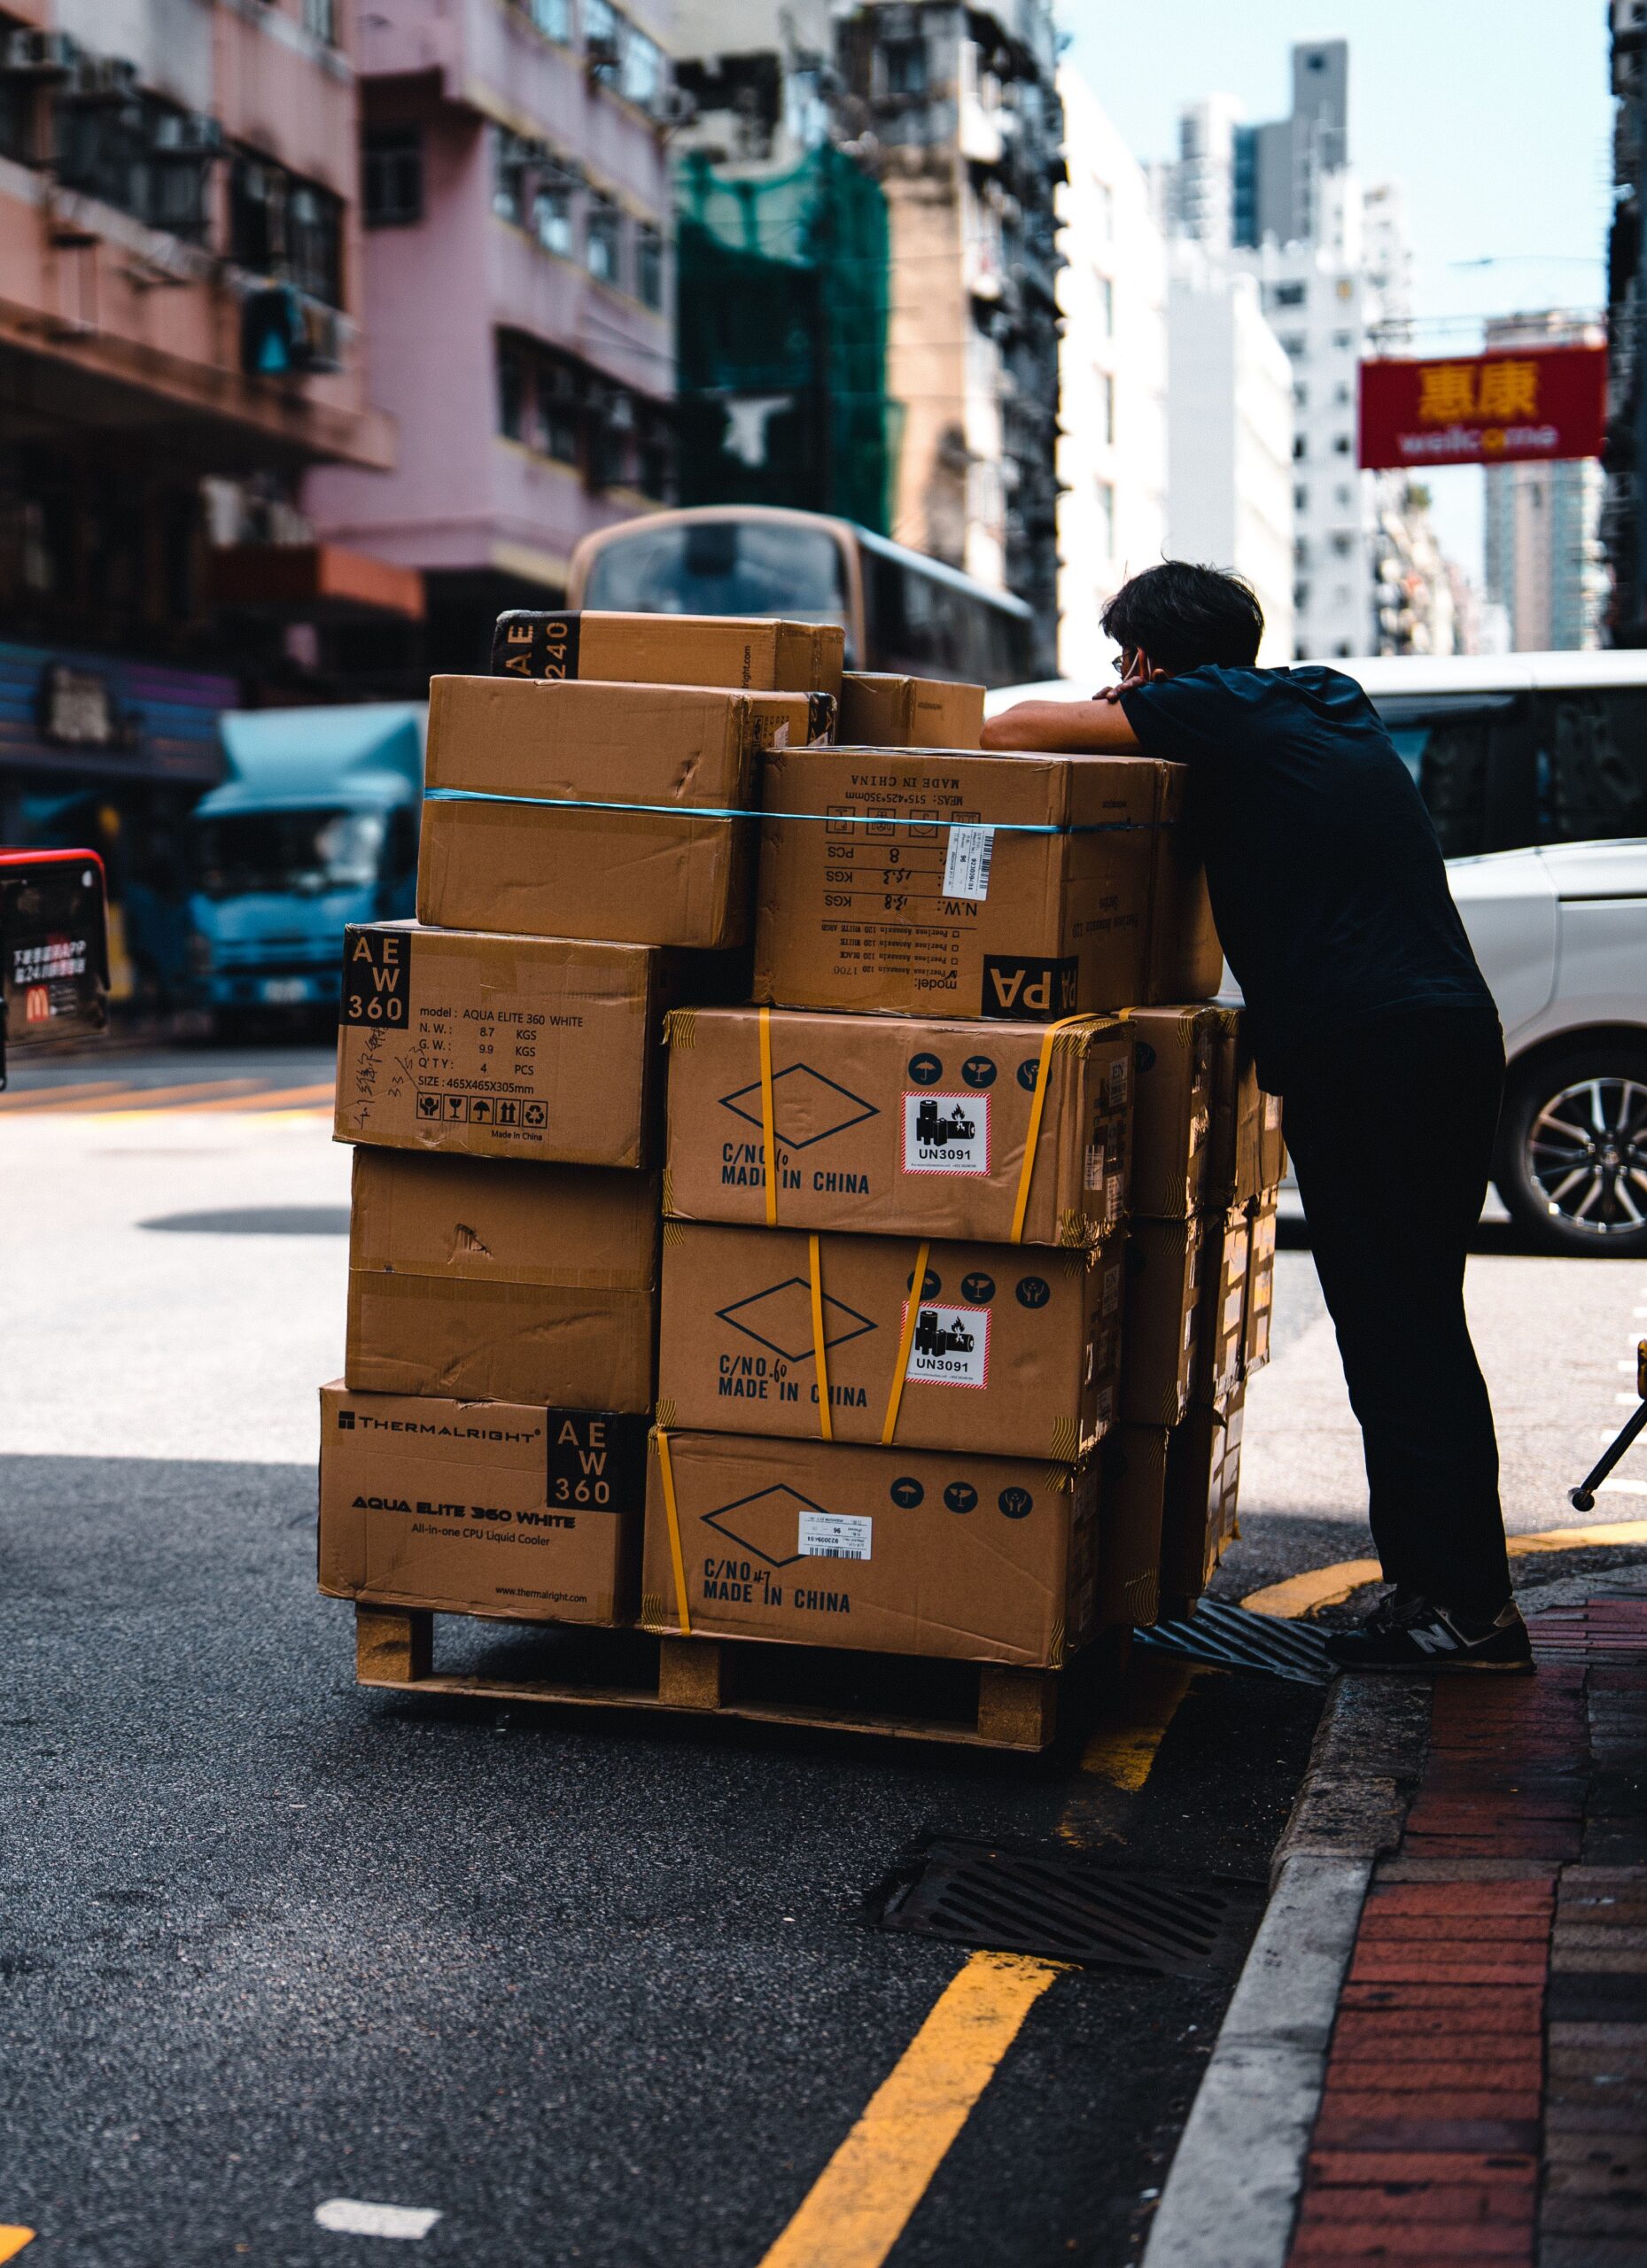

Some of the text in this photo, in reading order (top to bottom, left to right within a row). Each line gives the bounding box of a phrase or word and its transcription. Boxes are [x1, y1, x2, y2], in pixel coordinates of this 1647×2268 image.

[545, 622, 568, 679] 240
[851, 775, 959, 789] MADE IN CHINA
[827, 846, 900, 864] 8 PCS
[826, 871, 853, 882] KGS
[825, 895, 851, 907] KGS
[372, 967, 400, 992] W
[914, 977, 957, 990] model:
[990, 968, 1052, 1010] PA
[348, 995, 402, 1021] 360
[463, 1009, 494, 1021] AQUA
[498, 1012, 524, 1023] ELITE
[526, 1015, 545, 1025] 360
[550, 1016, 584, 1028] WHITE
[479, 1027, 495, 1037] 8.7
[517, 1029, 537, 1040] KGS
[478, 1044, 493, 1054] 9.9
[515, 1046, 536, 1057] KGS
[480, 1063, 487, 1074] 4
[514, 1064, 534, 1076] PCS
[447, 1077, 534, 1094] 465X465X305mm
[491, 1130, 511, 1139] Made
[523, 1132, 543, 1141] China
[919, 1149, 970, 1160] UN3091
[722, 1165, 869, 1194] MAD IN CHINA
[916, 1358, 968, 1372] UN3091
[719, 1377, 768, 1399] MADE
[780, 1382, 798, 1402] IN
[358, 1417, 535, 1443] THERMALRIGHT
[578, 1449, 608, 1476] W
[555, 1477, 610, 1503] 360
[352, 1495, 576, 1529] AQUA ELITE 360 WHITE
[412, 1523, 550, 1546] All-in-one CPU Liquid Cooler
[496, 1587, 587, 1603] www.thermalright.com
[703, 1581, 851, 1613] MADE IN CHINA
